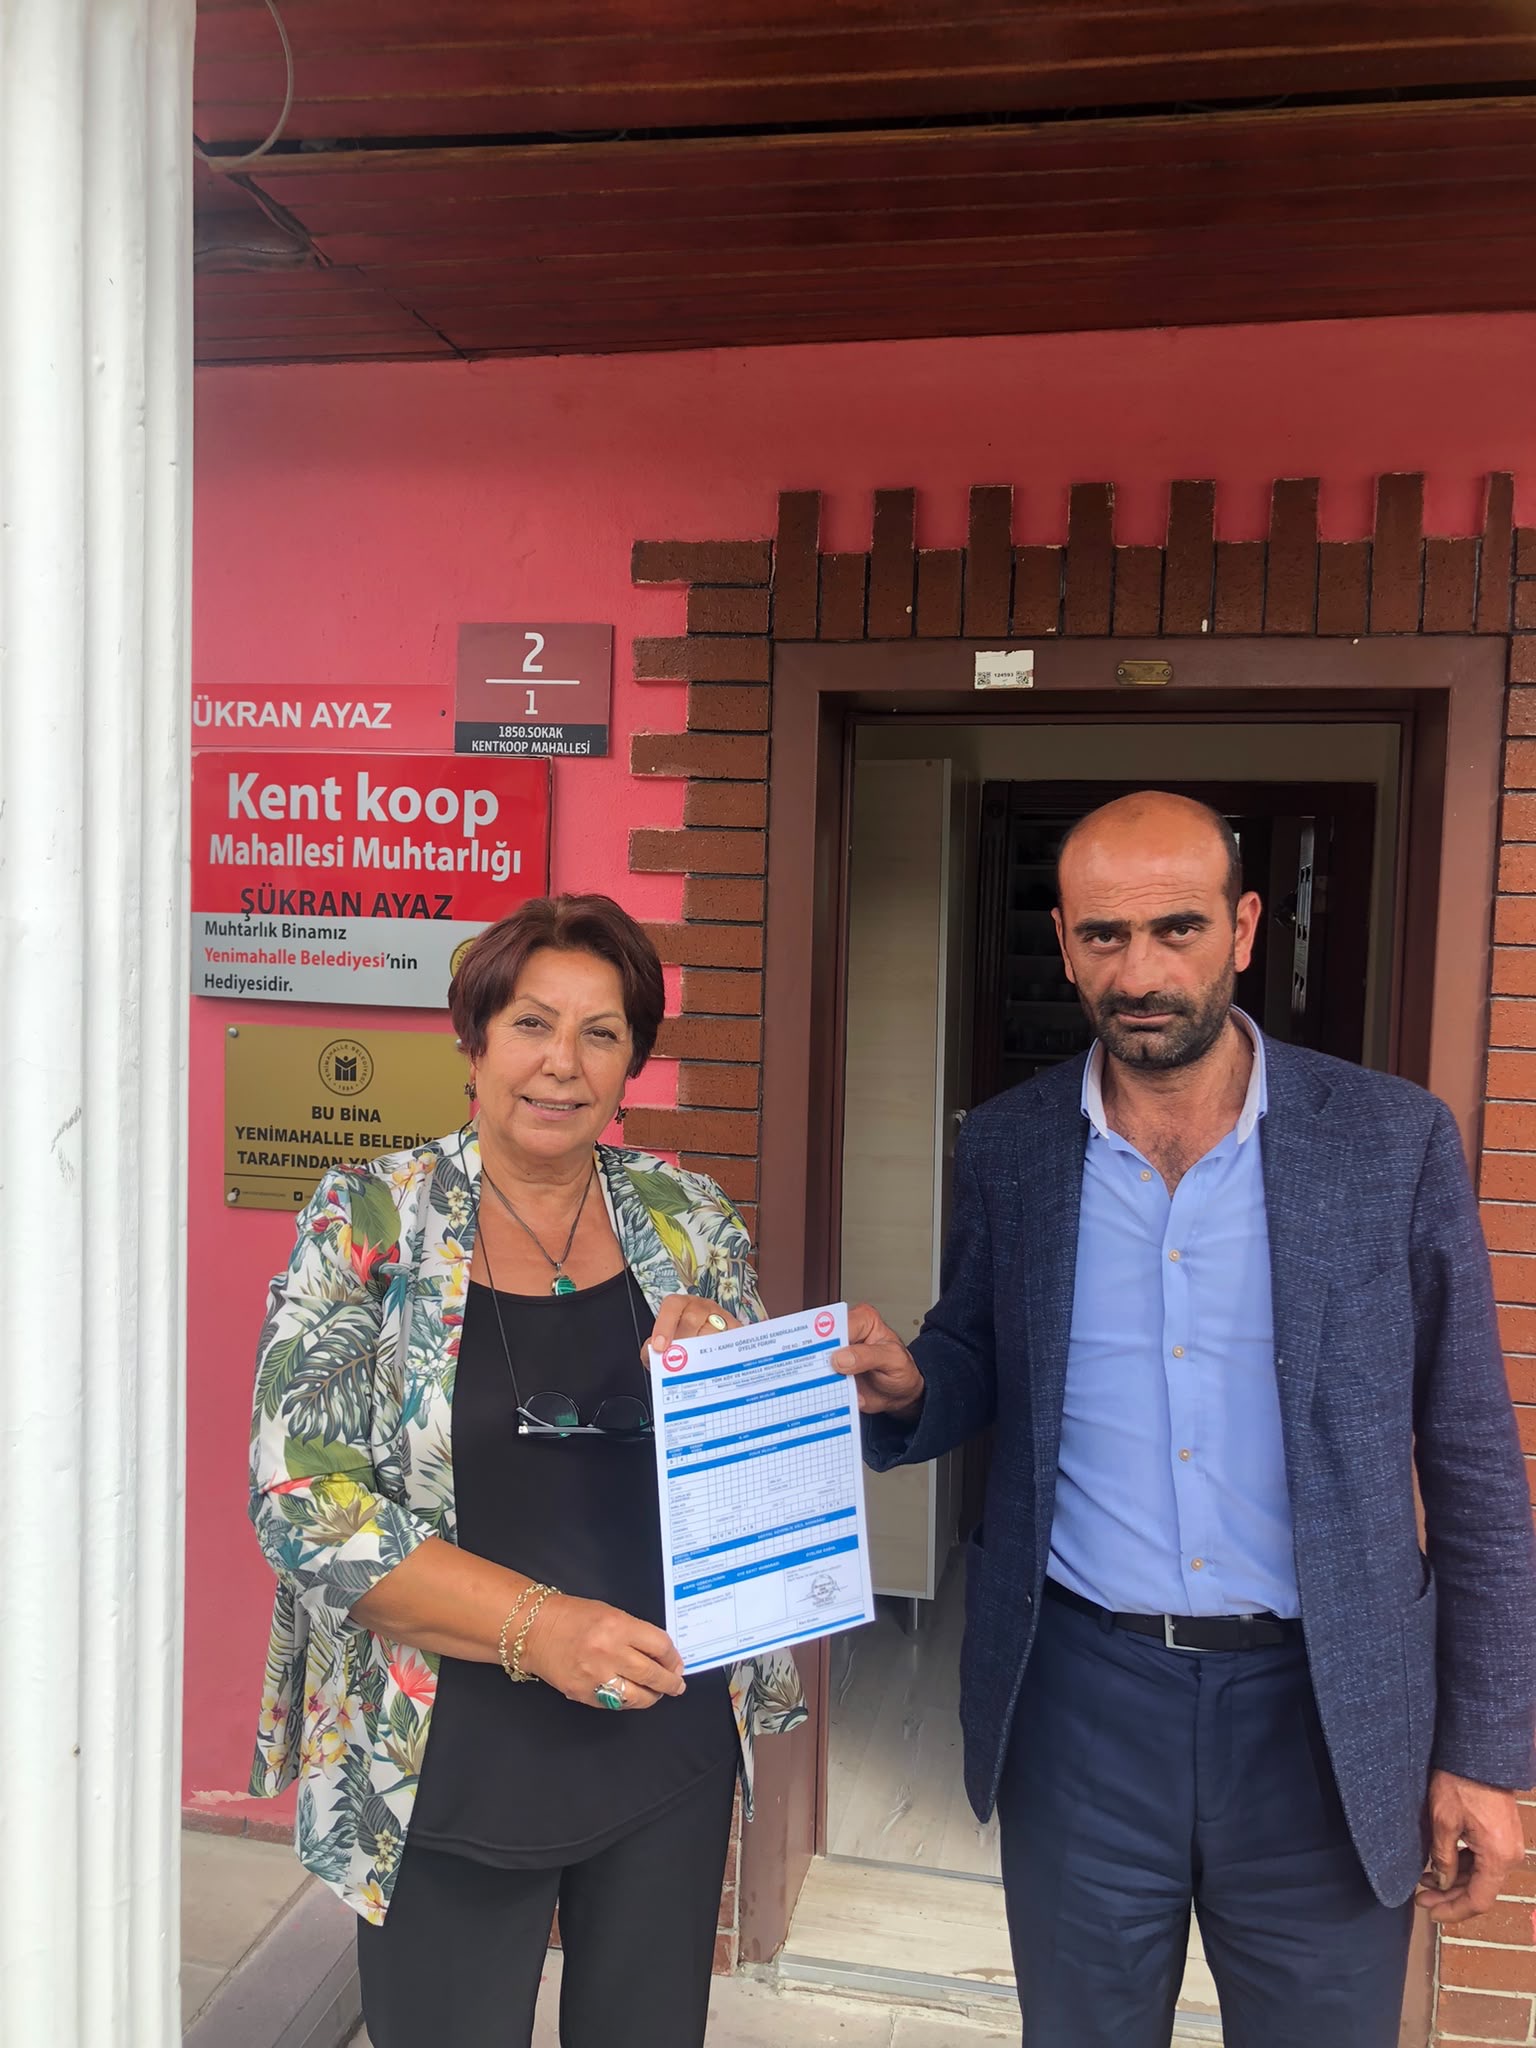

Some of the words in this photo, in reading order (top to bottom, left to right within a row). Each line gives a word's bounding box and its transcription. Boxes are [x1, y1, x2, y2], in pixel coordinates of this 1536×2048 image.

[522, 632, 545, 673] 2
[193, 695, 302, 728] ÜKRAN
[310, 702, 392, 729] AYAZ
[525, 690, 539, 715] 1
[498, 726, 563, 739] 1850.SOKAK
[471, 740, 529, 754] KENTKOOP
[530, 740, 590, 755] MAHALLESİ
[228, 772, 342, 822] Kent
[356, 771, 499, 838] koop
[209, 833, 344, 867] Mahallesi
[352, 836, 521, 882] Muhtarlığı
[240, 882, 362, 921] ŞÜKRAN
[371, 892, 453, 920] AYAZ
[204, 920, 278, 938] Muhtarlık
[281, 922, 347, 940] Binamız
[204, 947, 297, 965] Yenimahalle
[300, 949, 418, 972] Belediyesi'nin
[204, 973, 293, 994] Hediyesidir.
[311, 1106, 335, 1120] BU
[340, 1105, 382, 1122] BİNA
[235, 1125, 354, 1146] YENİMAHALLE
[359, 1133, 440, 1149] BELEDİY
[237, 1150, 343, 1169] TARAFINDAN
